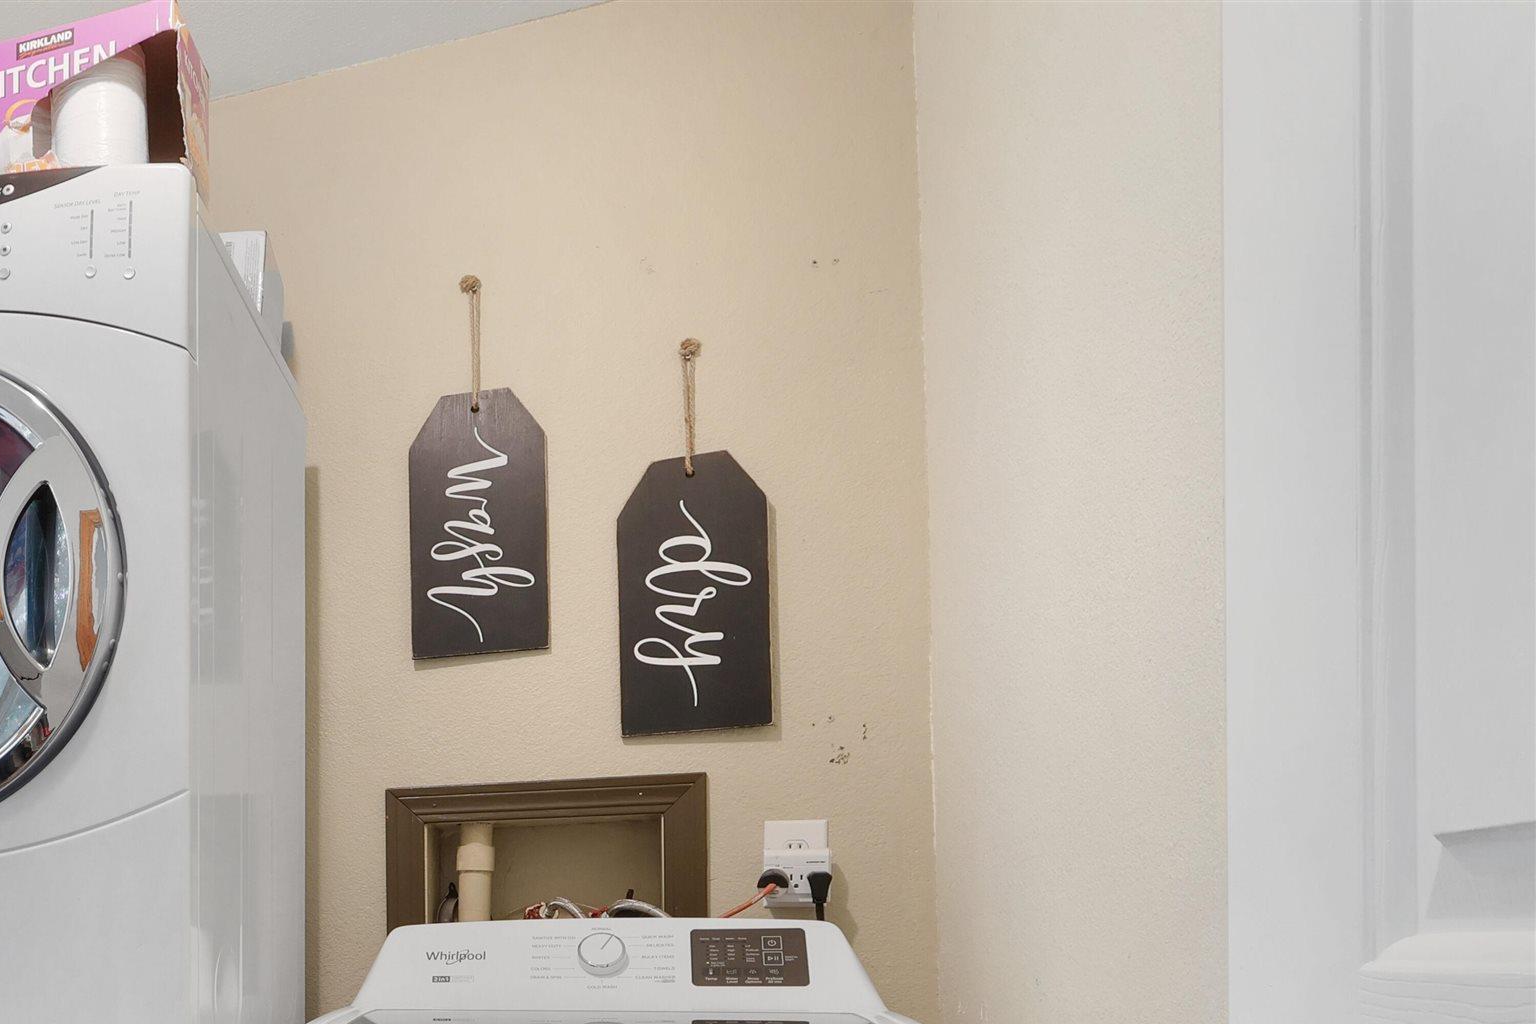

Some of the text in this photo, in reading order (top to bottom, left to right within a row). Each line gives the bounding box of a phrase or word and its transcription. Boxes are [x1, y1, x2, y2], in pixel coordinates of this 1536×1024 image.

[18, 30, 73, 54] KIRKLAND
[427, 427, 536, 643] wash
[634, 499, 752, 707] dry
[426, 949, 486, 966] Whirlpool
